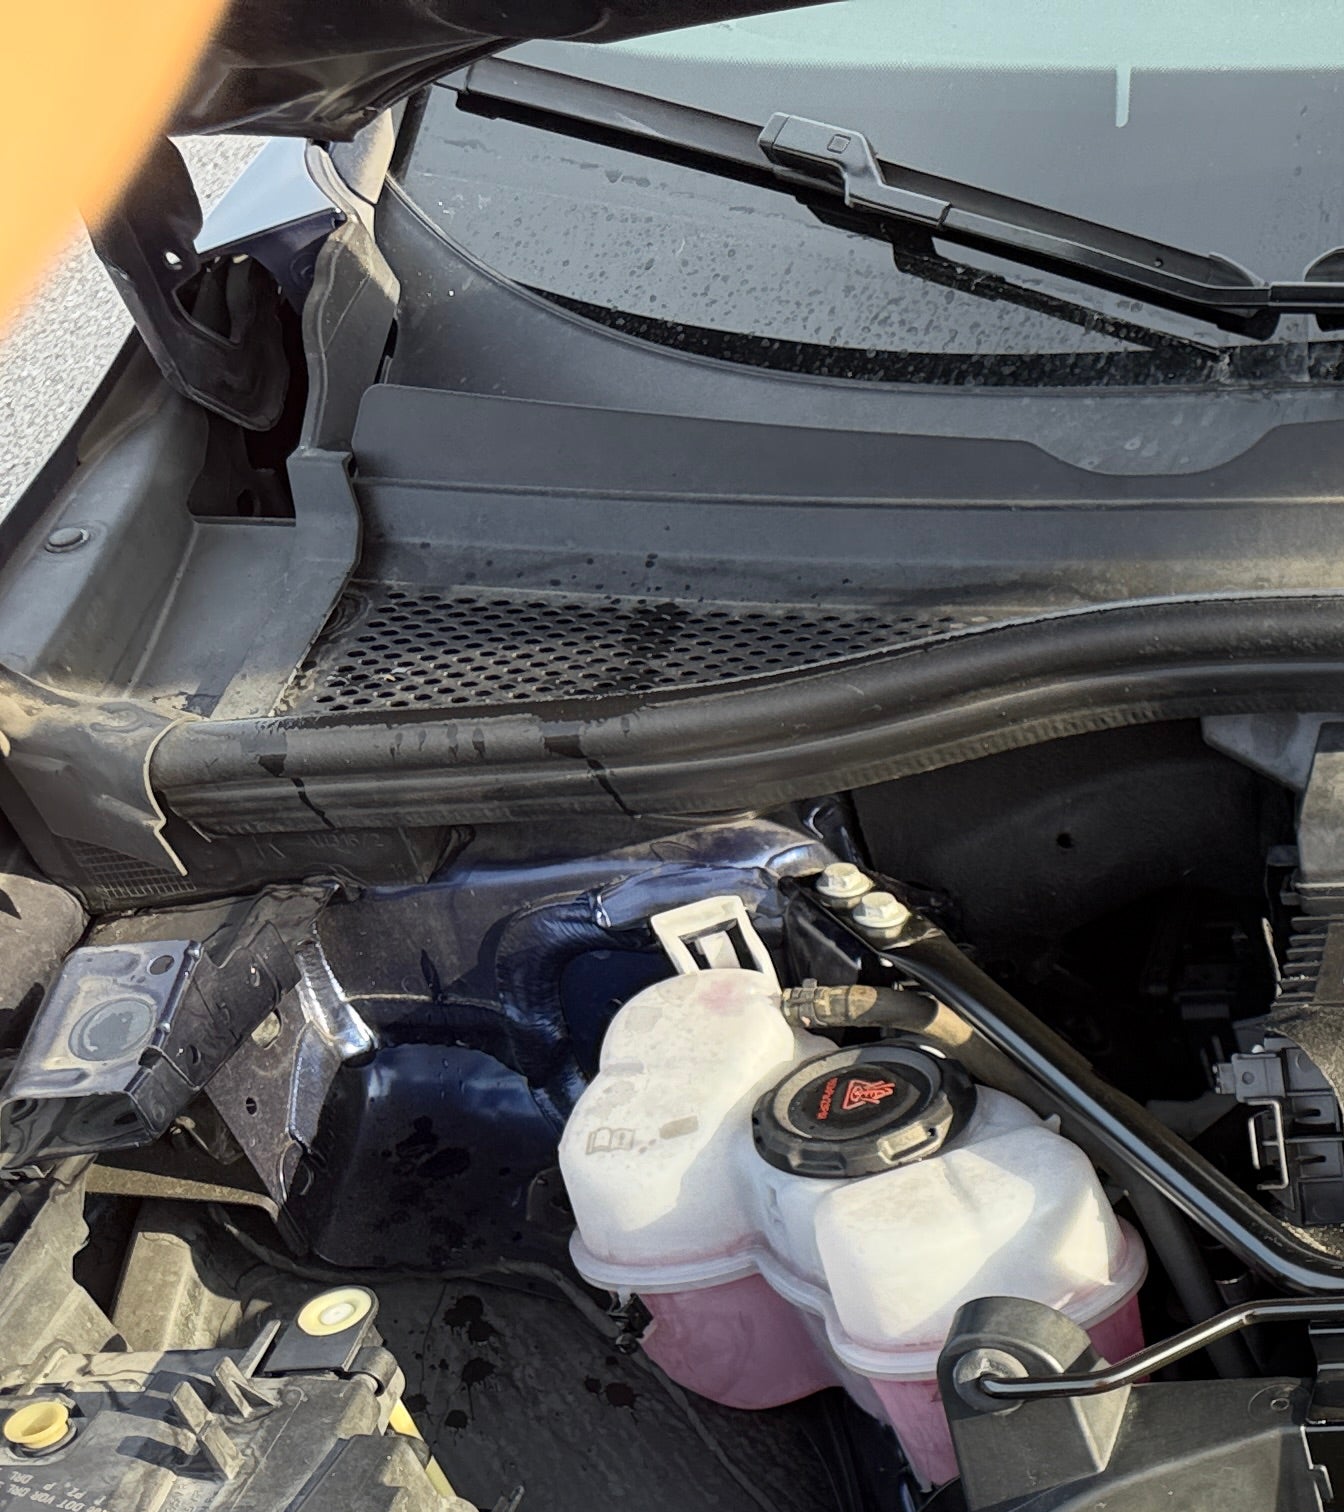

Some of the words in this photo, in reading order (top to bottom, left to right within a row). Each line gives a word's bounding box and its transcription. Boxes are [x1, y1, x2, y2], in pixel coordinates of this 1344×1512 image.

[9, 1471, 34, 1484] DRL
[7, 1484, 31, 1497] DRL
[30, 1490, 56, 1505] VOR
[56, 1499, 85, 1512] DOT
